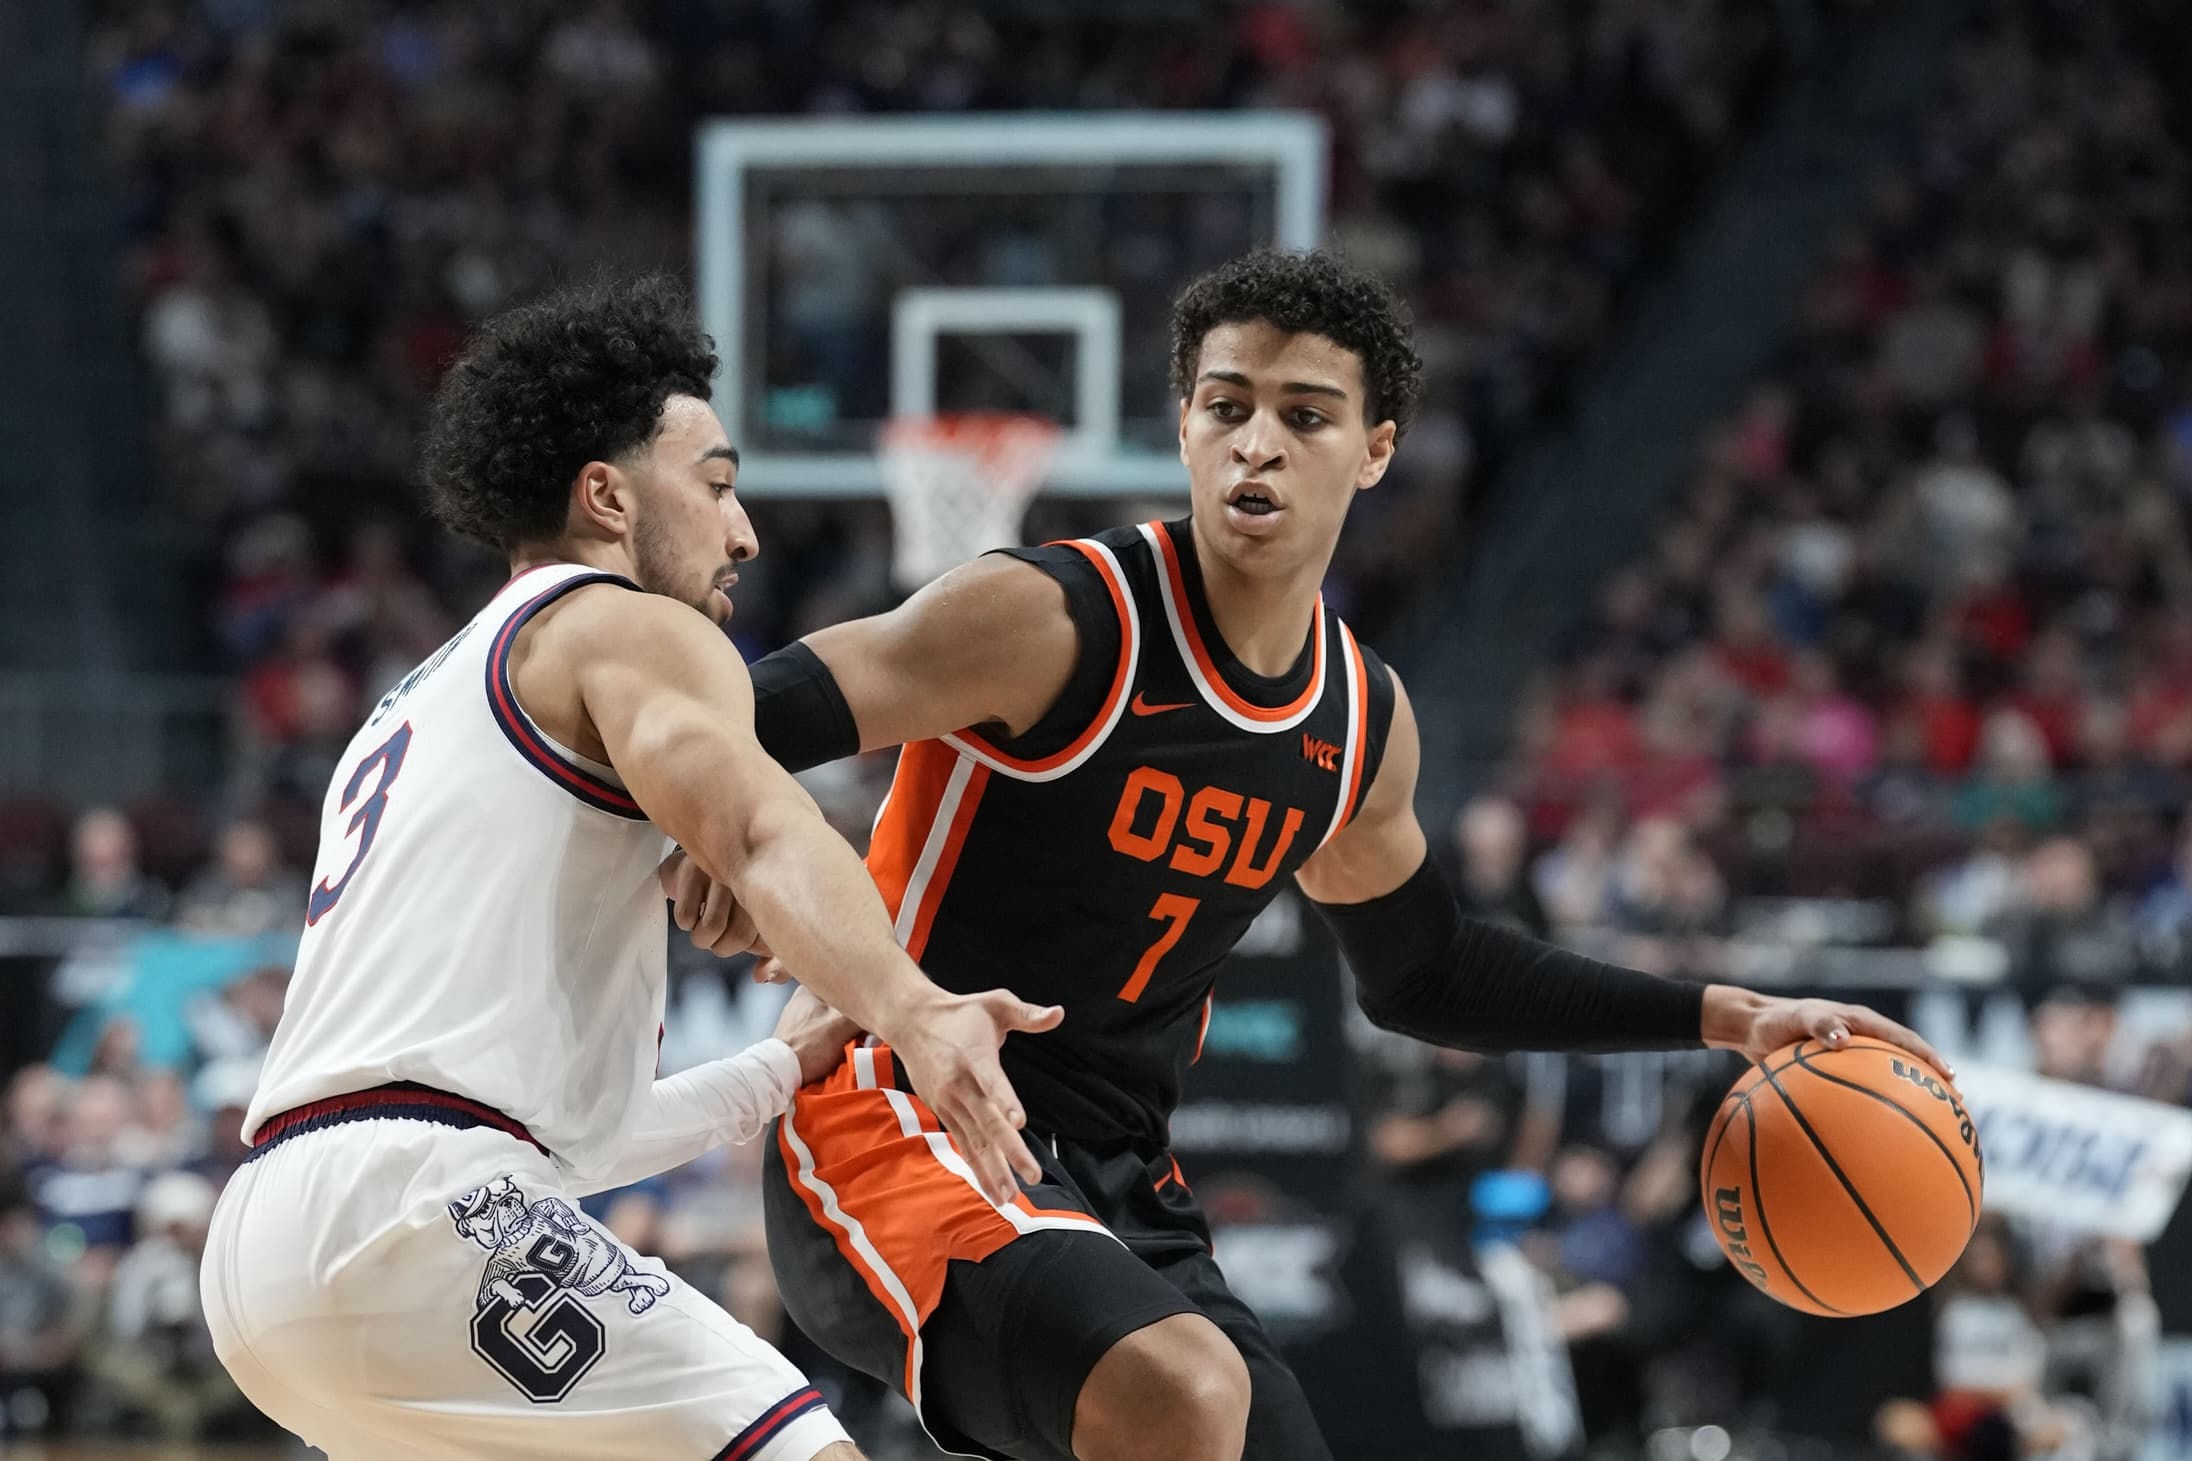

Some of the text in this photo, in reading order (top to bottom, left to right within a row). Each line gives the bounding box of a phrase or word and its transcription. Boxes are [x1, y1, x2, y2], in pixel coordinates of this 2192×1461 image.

[1303, 734, 1343, 772] WCC
[306, 720, 413, 927] 3
[1108, 766, 1304, 889] OSU
[1117, 893, 1200, 1003] 7
[526, 1233, 575, 1274] G
[470, 1271, 606, 1404] G
